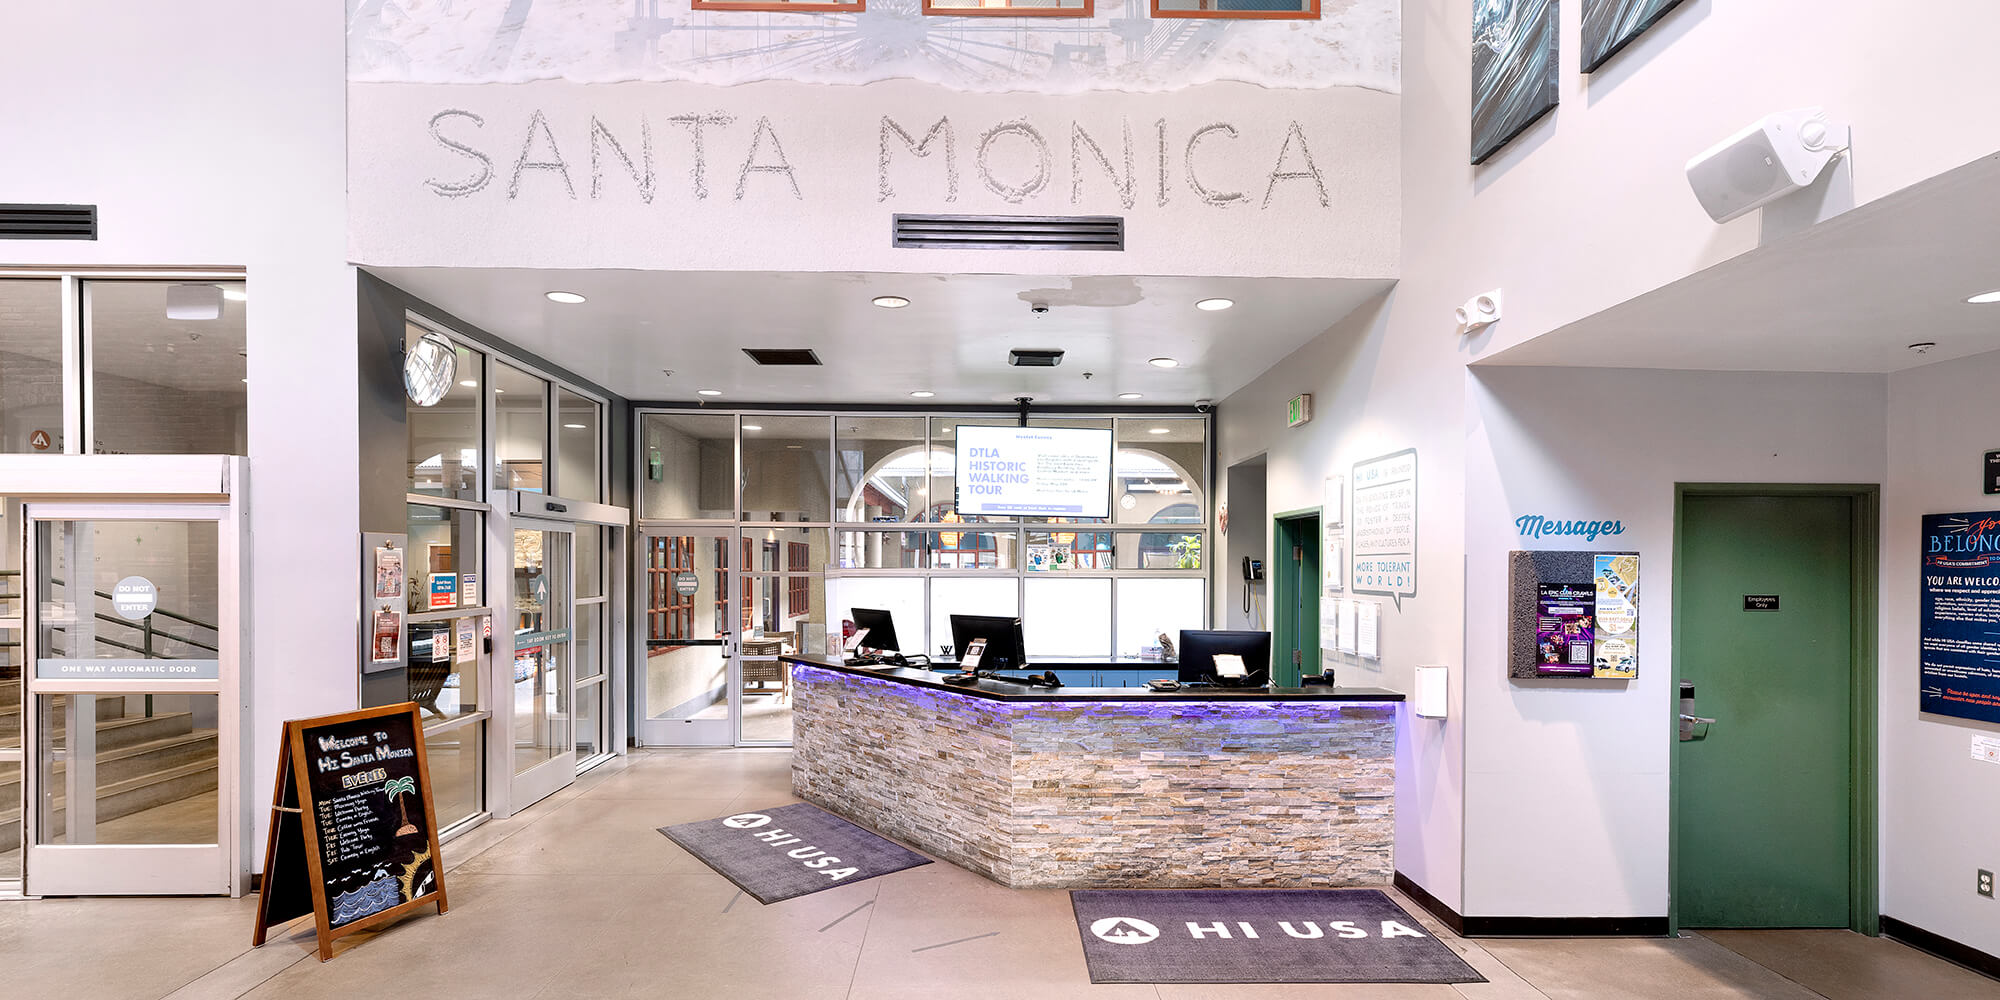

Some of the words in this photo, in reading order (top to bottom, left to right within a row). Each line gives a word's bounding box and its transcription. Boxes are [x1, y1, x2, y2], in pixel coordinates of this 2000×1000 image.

[423, 107, 803, 205] SANTA
[876, 115, 1330, 210] MONICA
[970, 447, 1000, 458] DTLA
[969, 461, 1026, 472] HISTORIC
[969, 473, 1029, 484] WALKING
[1367, 468, 1378, 480] USA
[968, 485, 1002, 495] TOUR
[1515, 514, 1626, 542] Messages
[1356, 562, 1373, 572] MORE
[1377, 562, 1411, 572] TOLERANT
[1927, 576, 1944, 586] YOU
[1947, 576, 1962, 585] ARE
[1965, 577, 2000, 586] WELCO
[373, 732, 388, 742] TO
[340, 751, 375, 769] SANTA
[375, 744, 413, 761] MONICA
[342, 767, 387, 788] EVENTS
[753, 828, 803, 847] HI
[787, 845, 860, 881] USA
[1185, 920, 1261, 940] HI
[1277, 920, 1428, 940] USA
